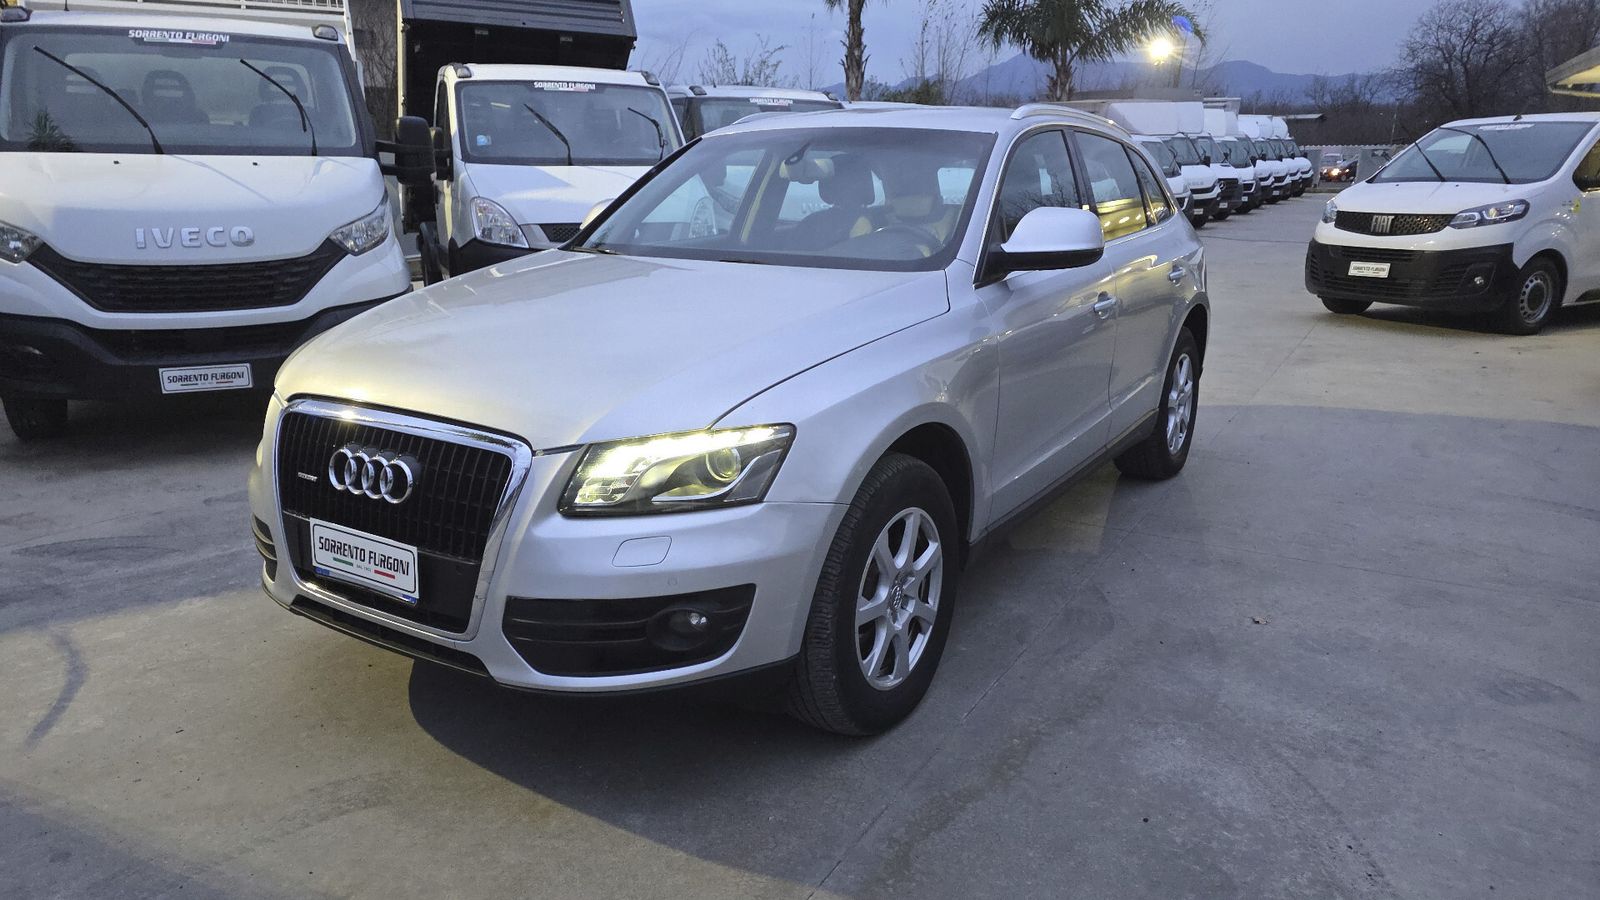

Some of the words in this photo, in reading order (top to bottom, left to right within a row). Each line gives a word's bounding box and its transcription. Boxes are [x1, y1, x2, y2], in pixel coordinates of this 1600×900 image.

[128, 29, 183, 39] SORRENTO
[185, 32, 230, 42] FURGONI
[1370, 215, 1395, 233] FIAT
[135, 226, 256, 249] IVECO
[167, 373, 209, 384] SORRENTO
[210, 371, 245, 380] FURGONI
[318, 536, 366, 563] SORRENTO
[368, 550, 410, 576] FURGONI
